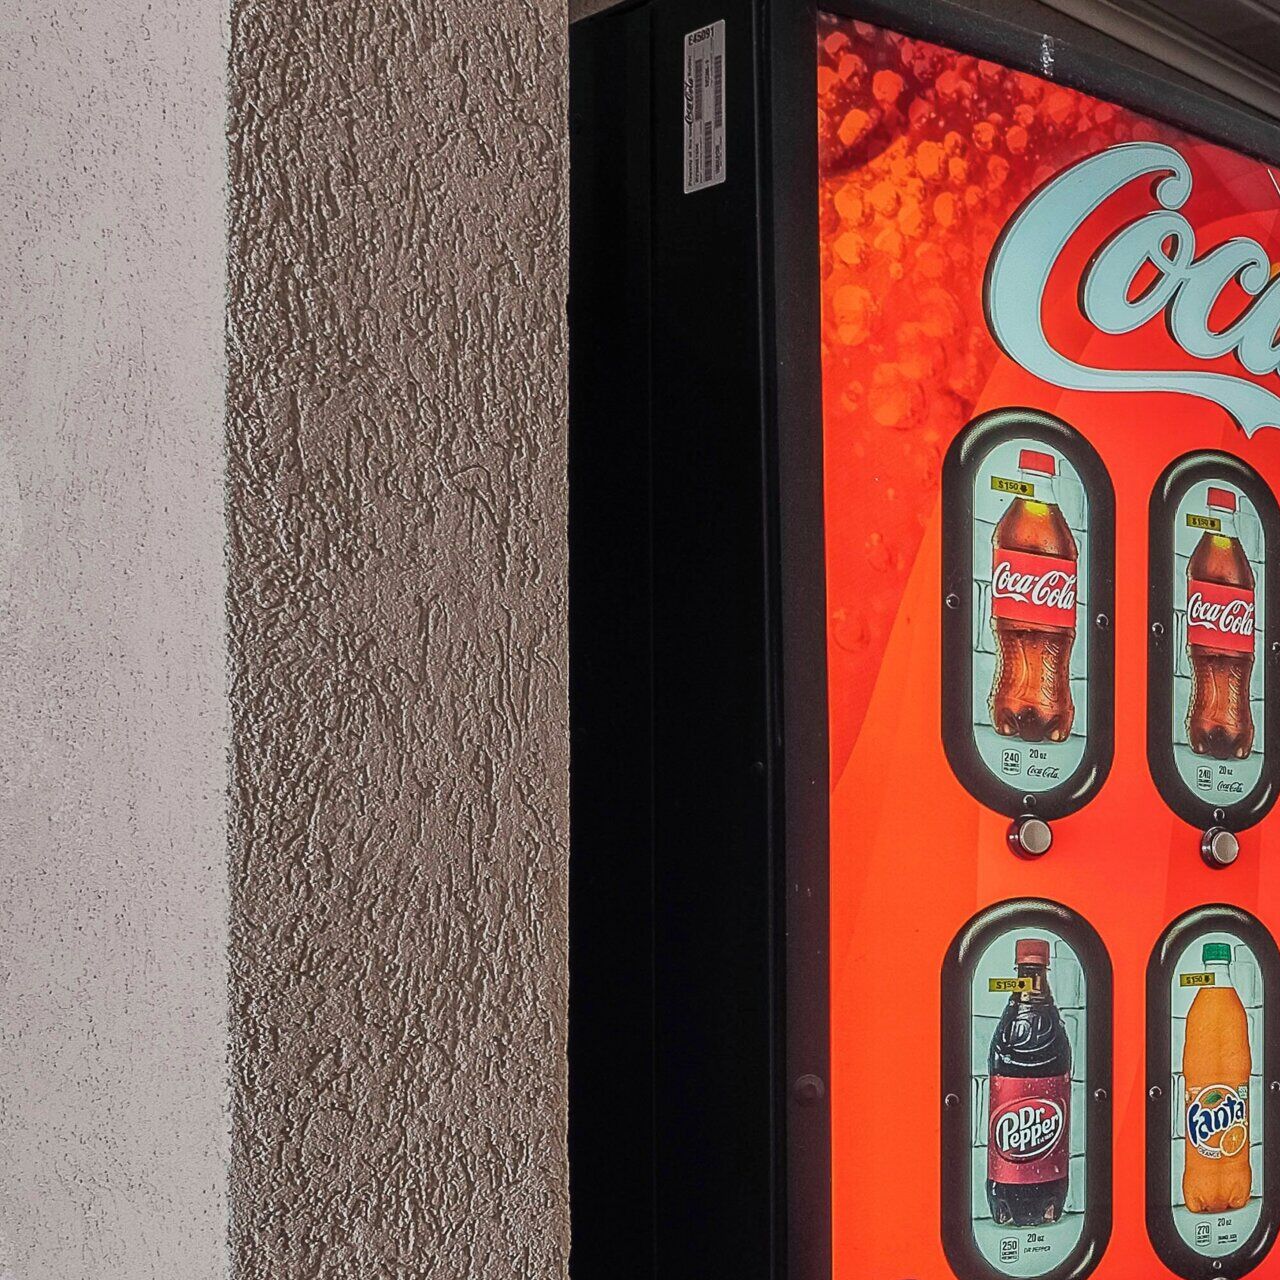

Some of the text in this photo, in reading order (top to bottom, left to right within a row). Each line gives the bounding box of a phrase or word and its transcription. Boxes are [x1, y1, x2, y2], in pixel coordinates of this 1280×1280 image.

[992, 562, 1076, 610] Coca-Cola
[1187, 592, 1255, 636] Coca-Cola
[1004, 752, 1019, 763] 240
[1029, 749, 1038, 759] 20
[1199, 769, 1211, 779] 240
[1219, 765, 1226, 774] 20
[1019, 1106, 1046, 1131] Dr
[1187, 1094, 1246, 1148] Fanta
[999, 1111, 1059, 1152] Pepper
[1218, 1218, 1225, 1226] 20
[1198, 1226, 1209, 1234] 270
[1027, 1233, 1036, 1242] 20
[1002, 1241, 1017, 1250] 250
